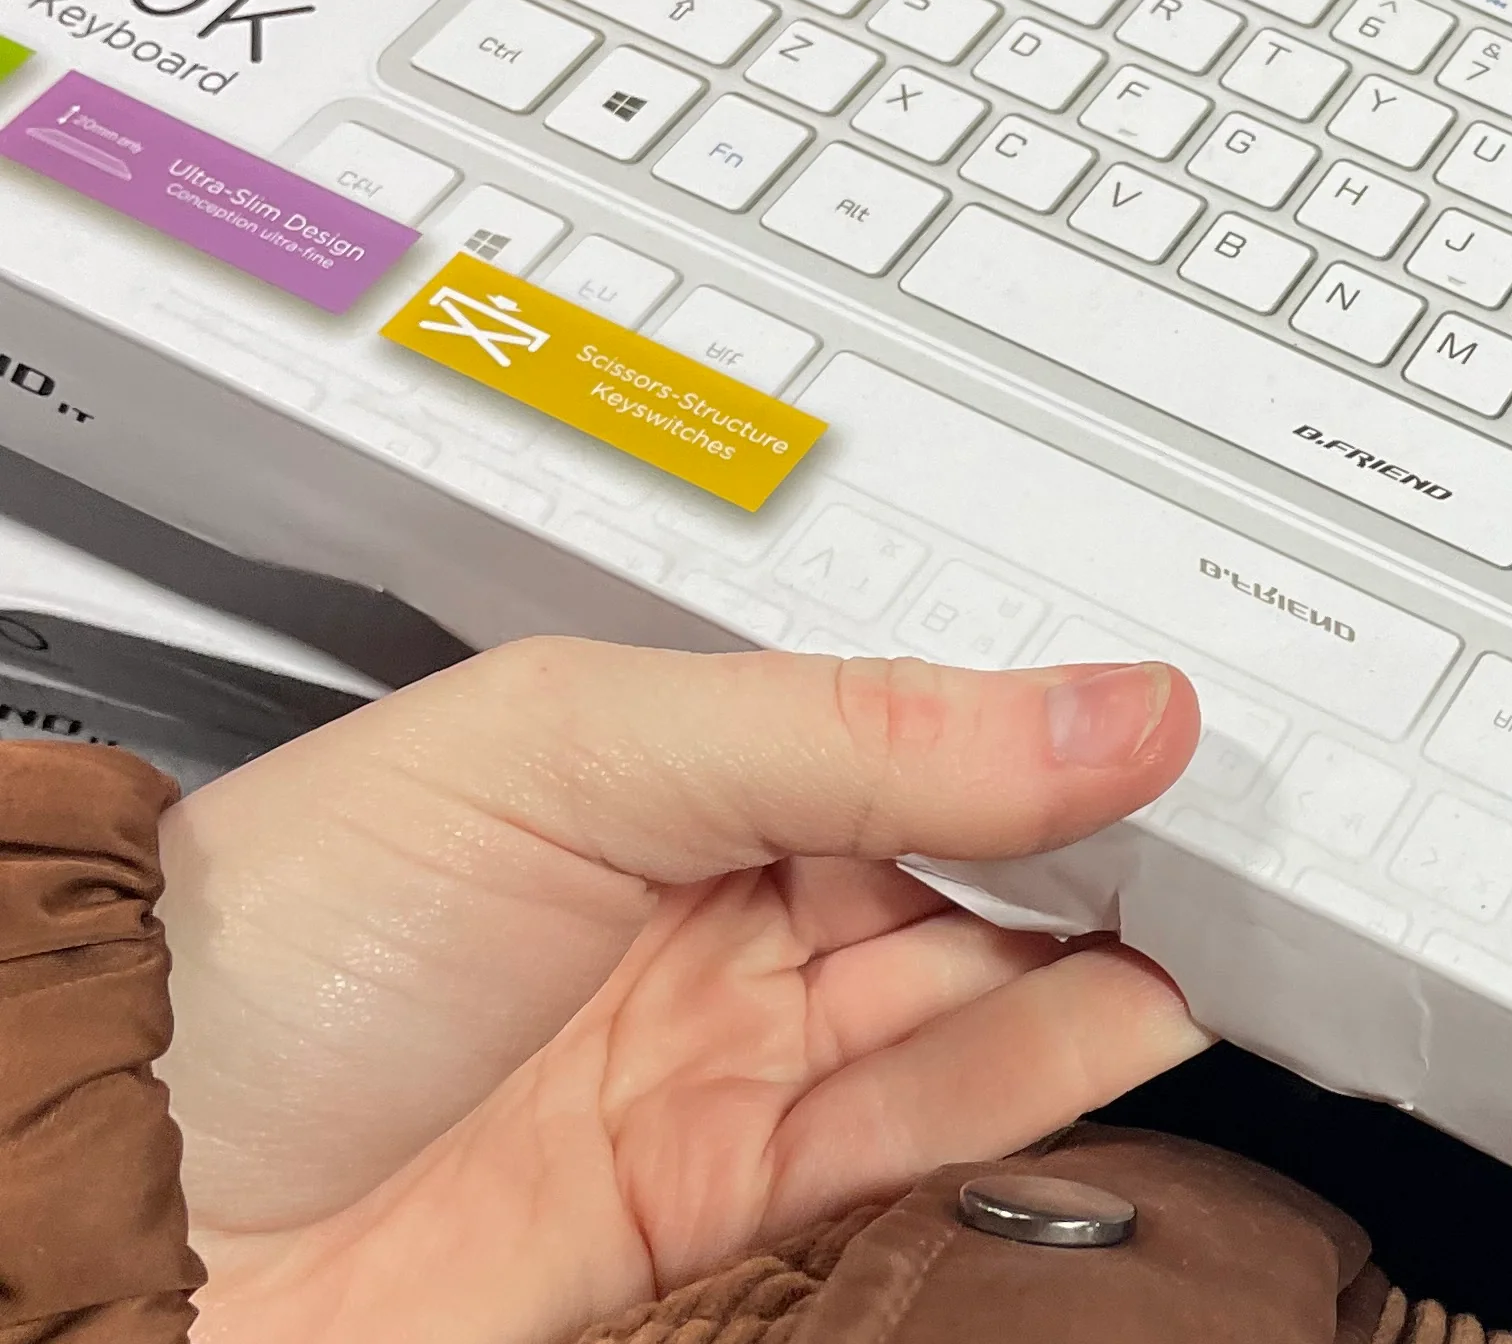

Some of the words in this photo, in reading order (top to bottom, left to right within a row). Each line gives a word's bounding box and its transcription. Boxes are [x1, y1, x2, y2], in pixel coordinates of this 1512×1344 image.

[1358, 15, 1386, 39] 6
[478, 36, 522, 64] Ctrl
[778, 34, 815, 63] Z
[1009, 31, 1042, 58] D
[1265, 41, 1293, 66] T
[1465, 60, 1491, 81] 7
[886, 83, 923, 112] X
[1116, 80, 1150, 100] F
[1371, 88, 1398, 113] Y
[708, 142, 744, 169] Fn
[994, 132, 1028, 159] C
[1224, 128, 1257, 155] G
[1472, 135, 1507, 163] U
[1112, 181, 1143, 208] V
[1334, 177, 1369, 206] H
[168, 158, 281, 222] Ultra-Slim
[283, 214, 366, 263] Design
[835, 198, 870, 223] Alt
[166, 183, 258, 233] Conception
[259, 228, 334, 270] ultra-fine
[1213, 230, 1248, 259] B
[1444, 232, 1476, 253] J
[1325, 281, 1361, 311] N
[1436, 331, 1479, 365] M
[576, 344, 789, 456] Scissors-Structure
[591, 382, 736, 461] Keyswitches
[1292, 424, 1453, 501] B.FRIEND
